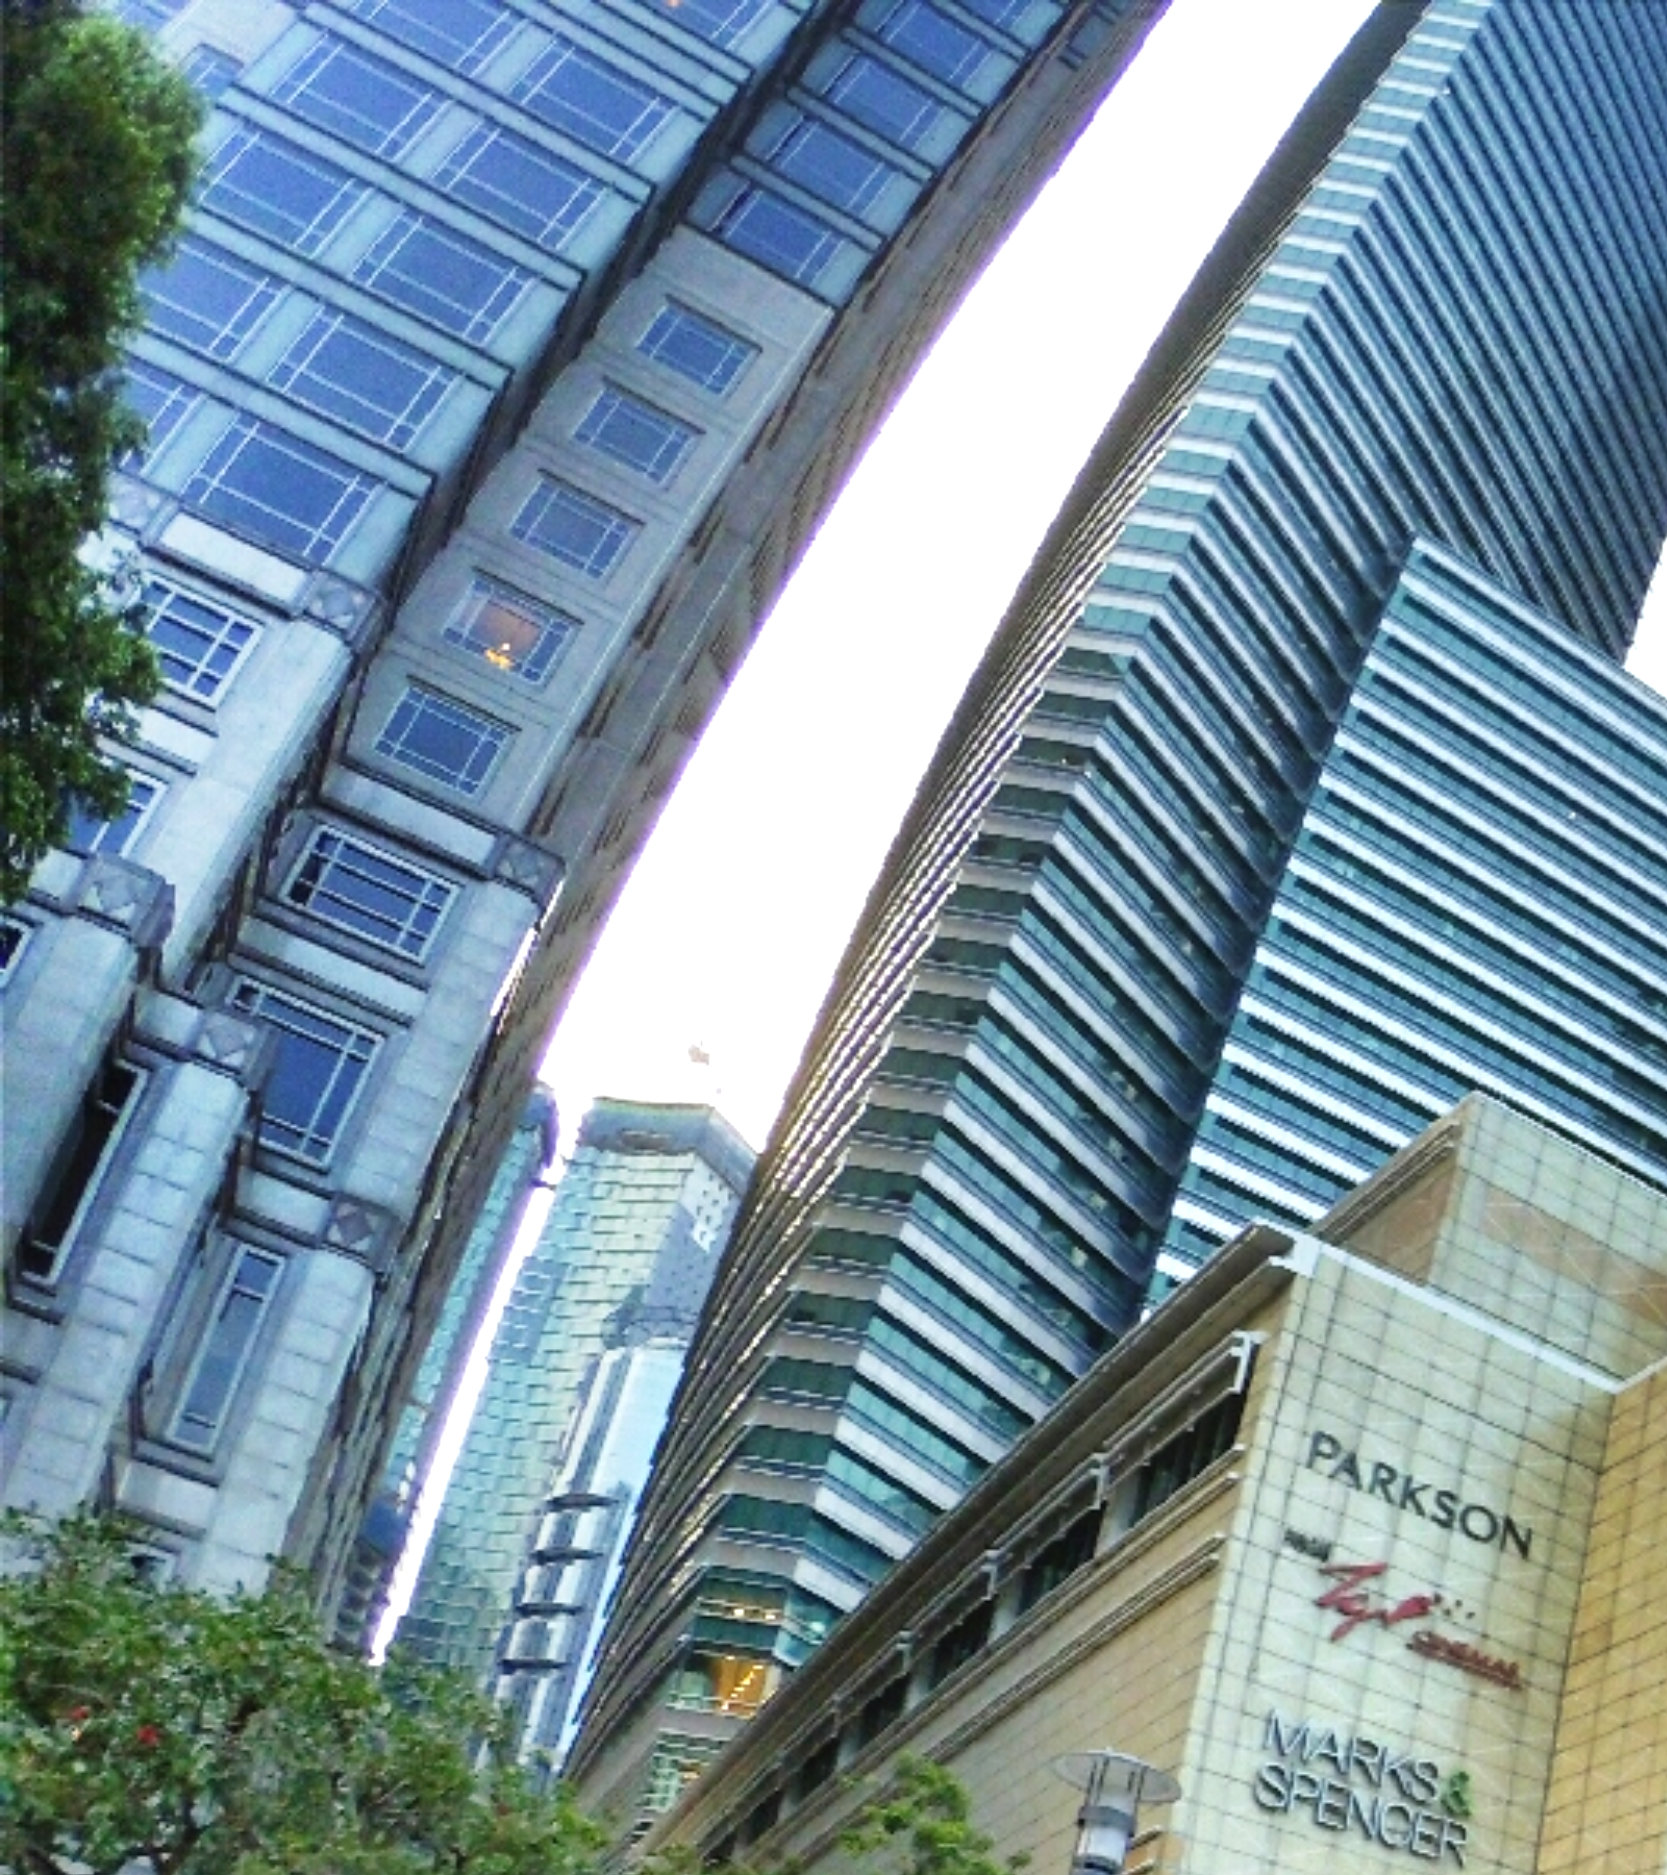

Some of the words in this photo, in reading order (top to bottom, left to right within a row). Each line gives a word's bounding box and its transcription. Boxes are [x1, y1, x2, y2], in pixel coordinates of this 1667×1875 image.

[1307, 1431, 1532, 1559] PARKSON
[1254, 1763, 1468, 1869] SPENCER
[1264, 1707, 1439, 1804] MARKS
[1441, 1771, 1471, 1817] &
